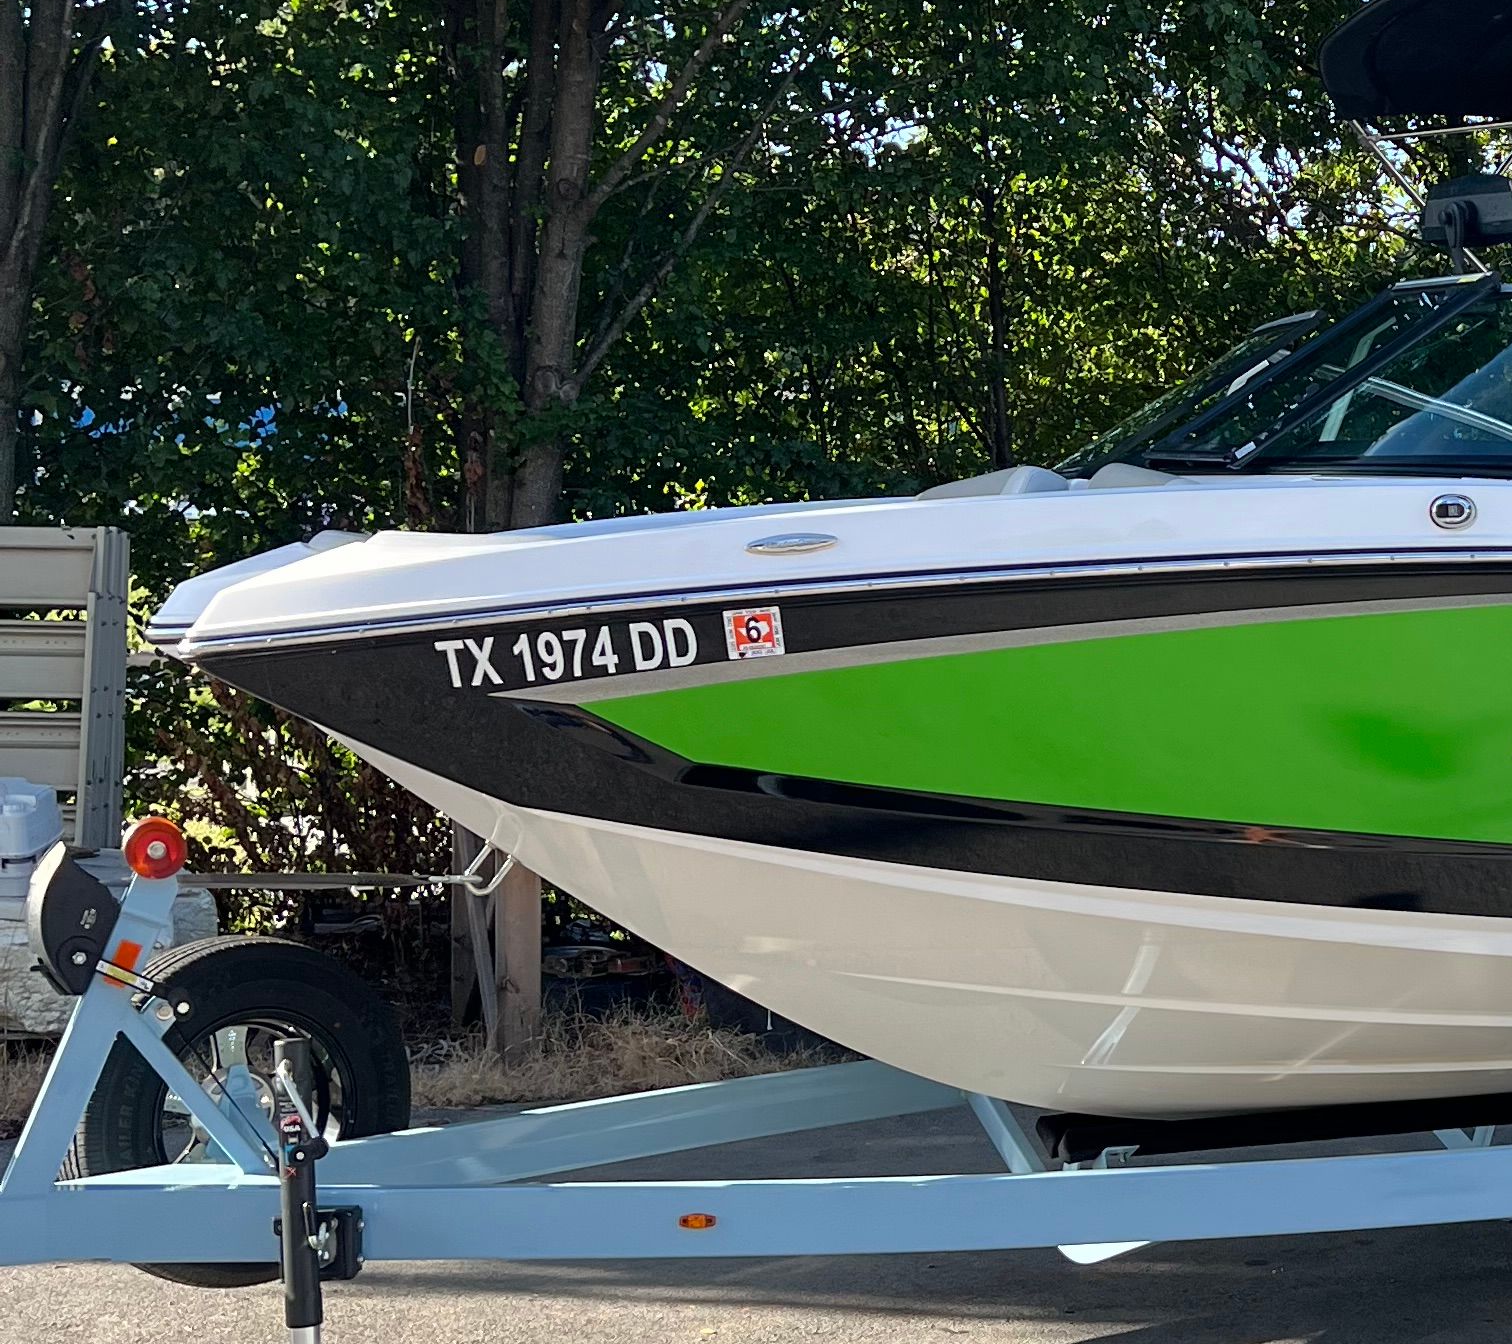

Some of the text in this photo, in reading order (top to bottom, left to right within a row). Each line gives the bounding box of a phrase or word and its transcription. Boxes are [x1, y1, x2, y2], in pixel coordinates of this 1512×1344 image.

[434, 636, 504, 688] TX
[513, 625, 619, 682] 1974
[629, 618, 698, 671] DD
[745, 616, 762, 643] 6
